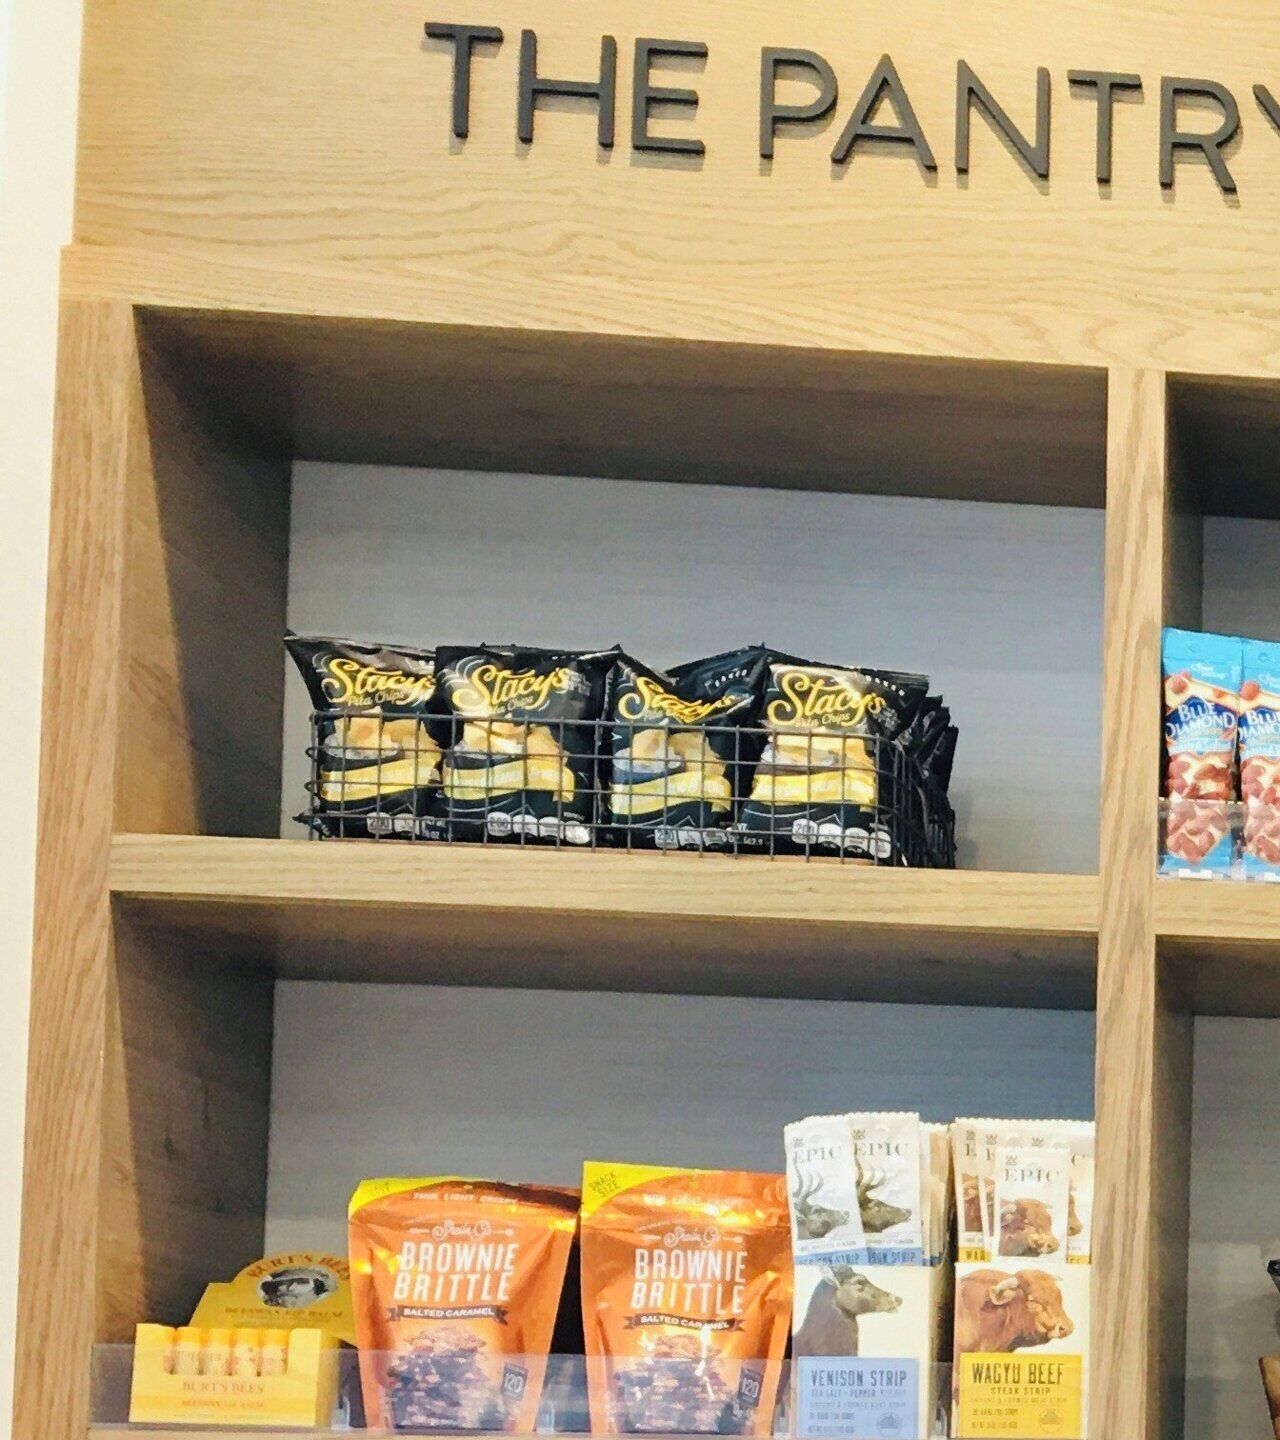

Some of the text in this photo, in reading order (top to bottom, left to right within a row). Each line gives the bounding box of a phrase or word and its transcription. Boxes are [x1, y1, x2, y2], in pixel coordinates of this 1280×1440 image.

[425, 22, 708, 157] THE
[766, 670, 886, 726] Stacy's
[1178, 703, 1218, 722] BLUE
[1005, 1167, 1060, 1184] EPIC
[400, 1241, 519, 1274] BROWNIE
[634, 1248, 749, 1284] BROWNIE
[393, 1272, 513, 1302] BRITTLE
[630, 1282, 745, 1315] BRITTLE
[404, 1307, 495, 1317] SALTED CARAMEL
[811, 1369, 907, 1387] VENISON STRIP
[972, 1363, 1065, 1384] WAGYU BEEF
